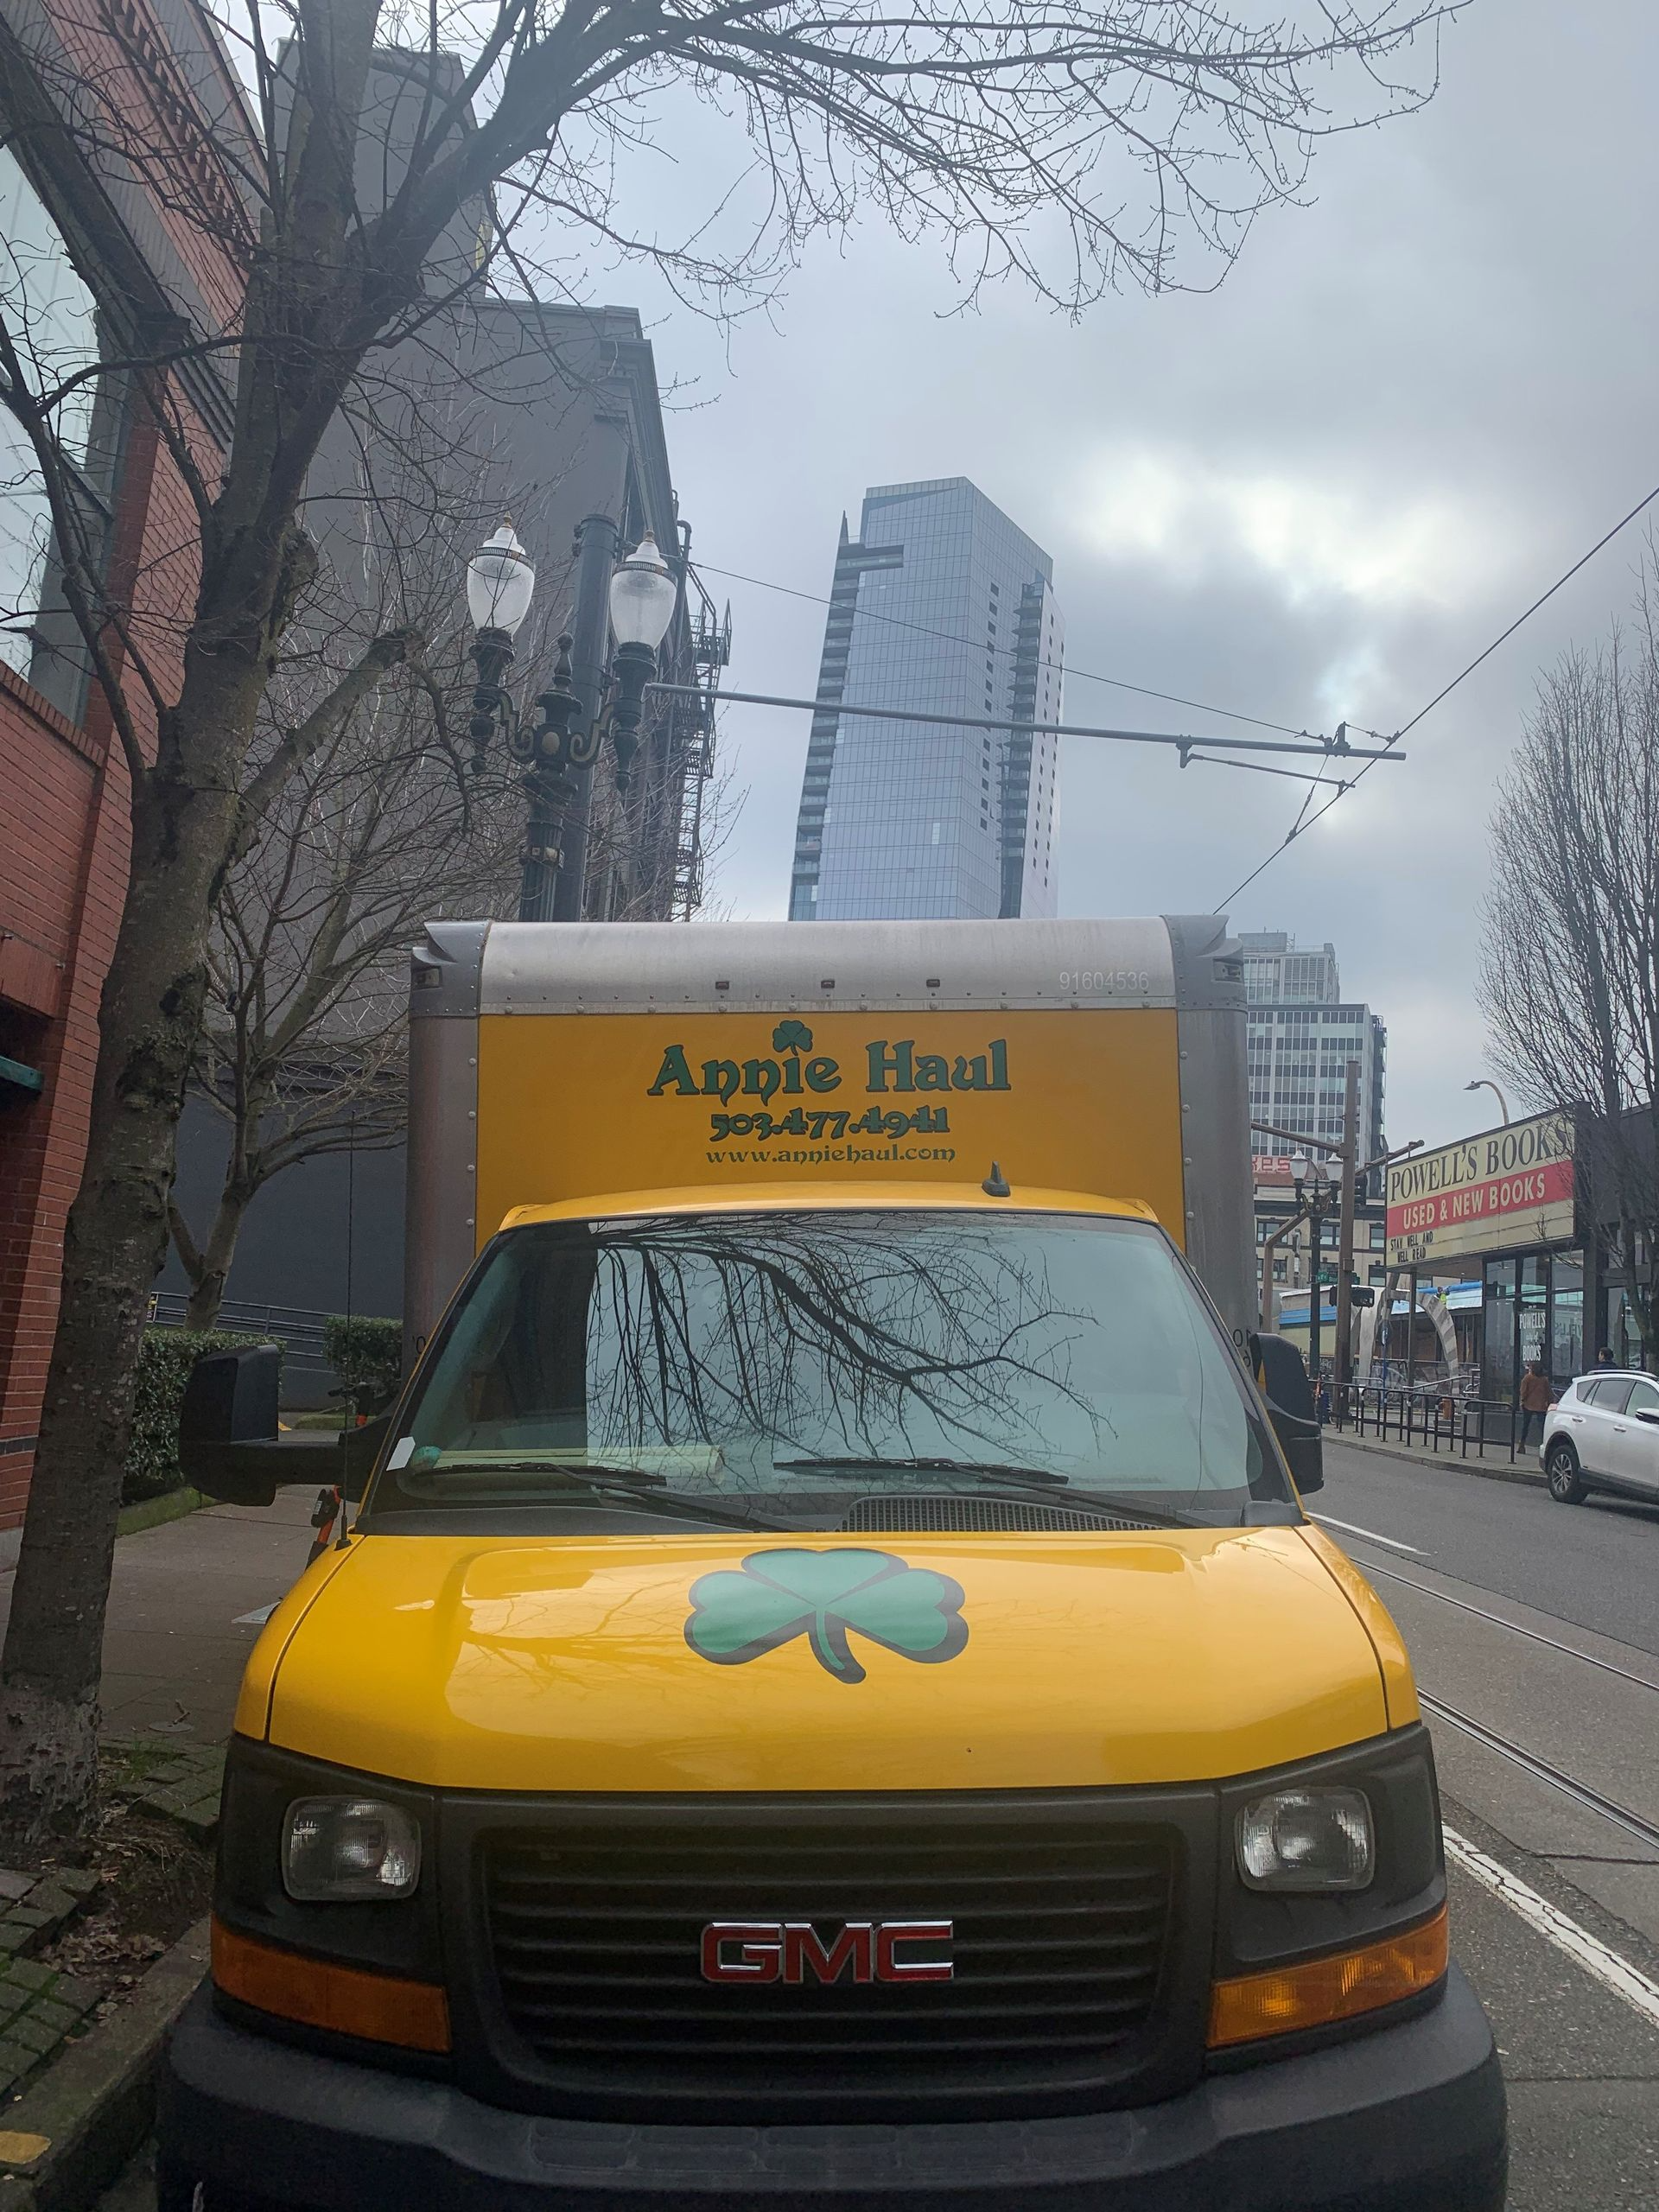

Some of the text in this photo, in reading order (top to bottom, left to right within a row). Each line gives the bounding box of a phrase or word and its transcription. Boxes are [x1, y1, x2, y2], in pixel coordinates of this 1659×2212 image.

[1059, 971, 1149, 990] 91604536
[646, 1039, 1011, 1107] Annie Haul
[709, 1104, 950, 1141] 503.477.4941
[705, 1143, 956, 1165] www.anniehaul.com
[1390, 1120, 1567, 1202] POWELL'S BOOKS
[1403, 1173, 1545, 1230] USED & NEW BOOKS
[1390, 1230, 1433, 1251] STAY WELL AND
[1397, 1247, 1427, 1262] WELL READ
[1519, 1312, 1546, 1329] POWELL'S
[1522, 1344, 1541, 1361] BOOKS
[701, 1921, 953, 1984] GMC
